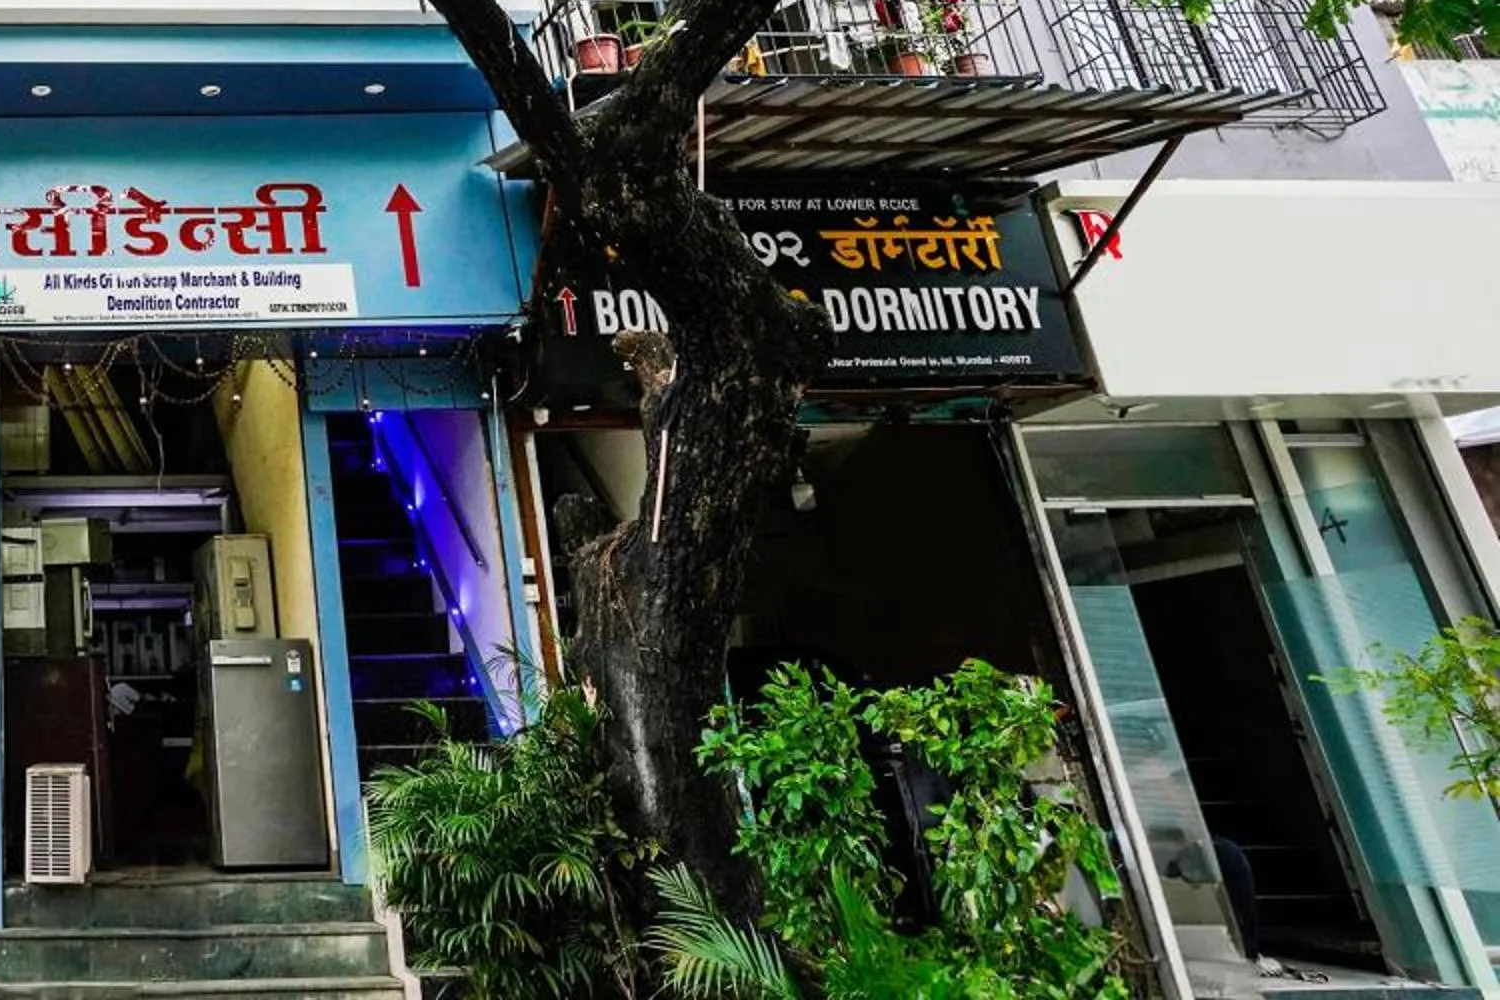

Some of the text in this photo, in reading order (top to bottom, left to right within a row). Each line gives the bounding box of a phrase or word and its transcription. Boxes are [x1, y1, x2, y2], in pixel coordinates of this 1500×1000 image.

[738, 199, 766, 211] FOR
[771, 199, 803, 211] STAY
[806, 199, 823, 211] AT
[827, 198, 876, 211] LOWER
[63, 273, 99, 290] Kinds
[143, 274, 177, 291] Scrap
[181, 271, 237, 288] Marchant
[240, 271, 250, 287] &
[253, 270, 302, 290] Building
[107, 294, 241, 311] Demolition Contractor
[821, 286, 1042, 334] DORMITORY
